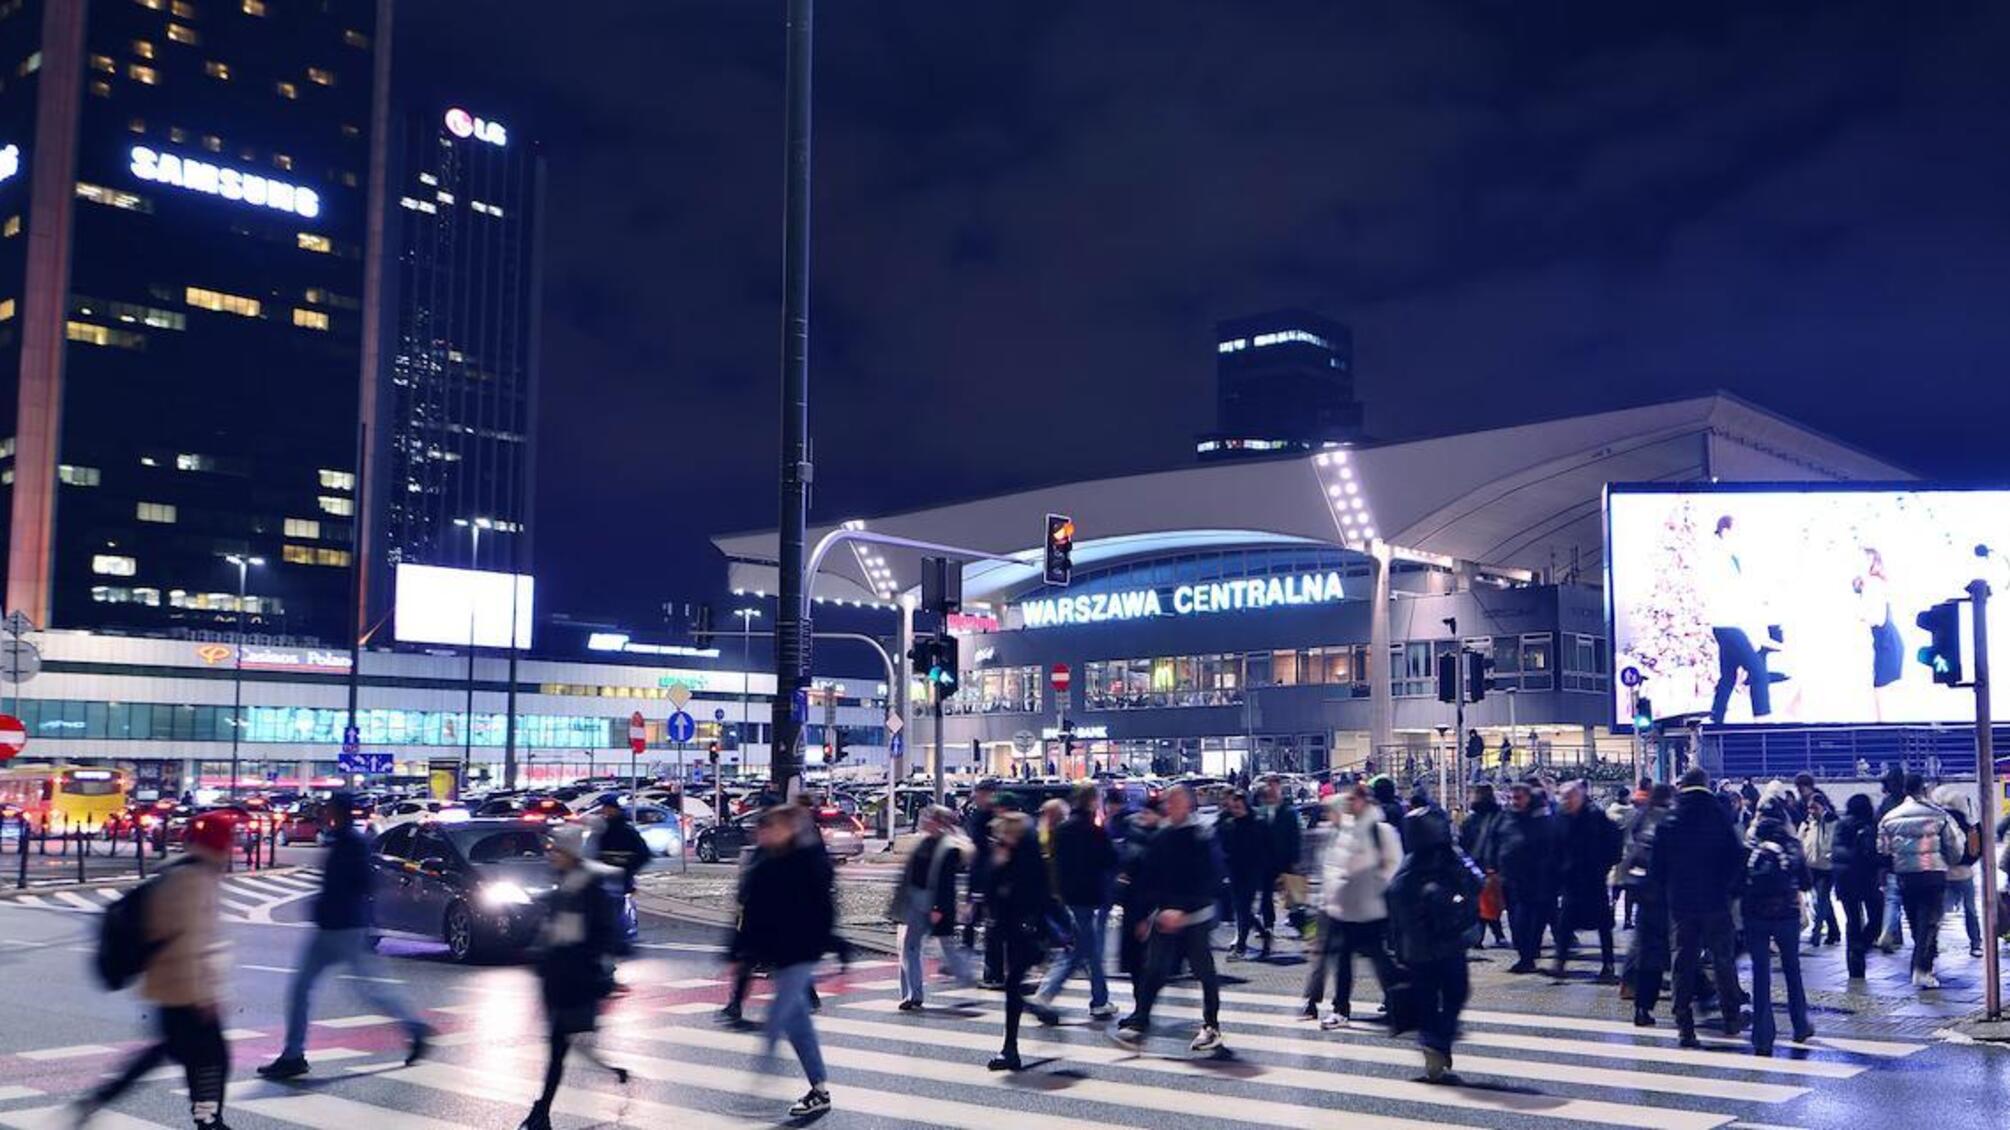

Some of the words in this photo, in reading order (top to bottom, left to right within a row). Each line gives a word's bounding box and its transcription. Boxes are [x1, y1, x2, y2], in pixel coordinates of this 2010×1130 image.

[473, 117, 507, 146] LG
[130, 146, 319, 218] SAMSUNG
[1021, 589, 1161, 628] WARSZAWA
[1173, 572, 1345, 615] CENTRALNA
[306, 651, 353, 668] Polan
